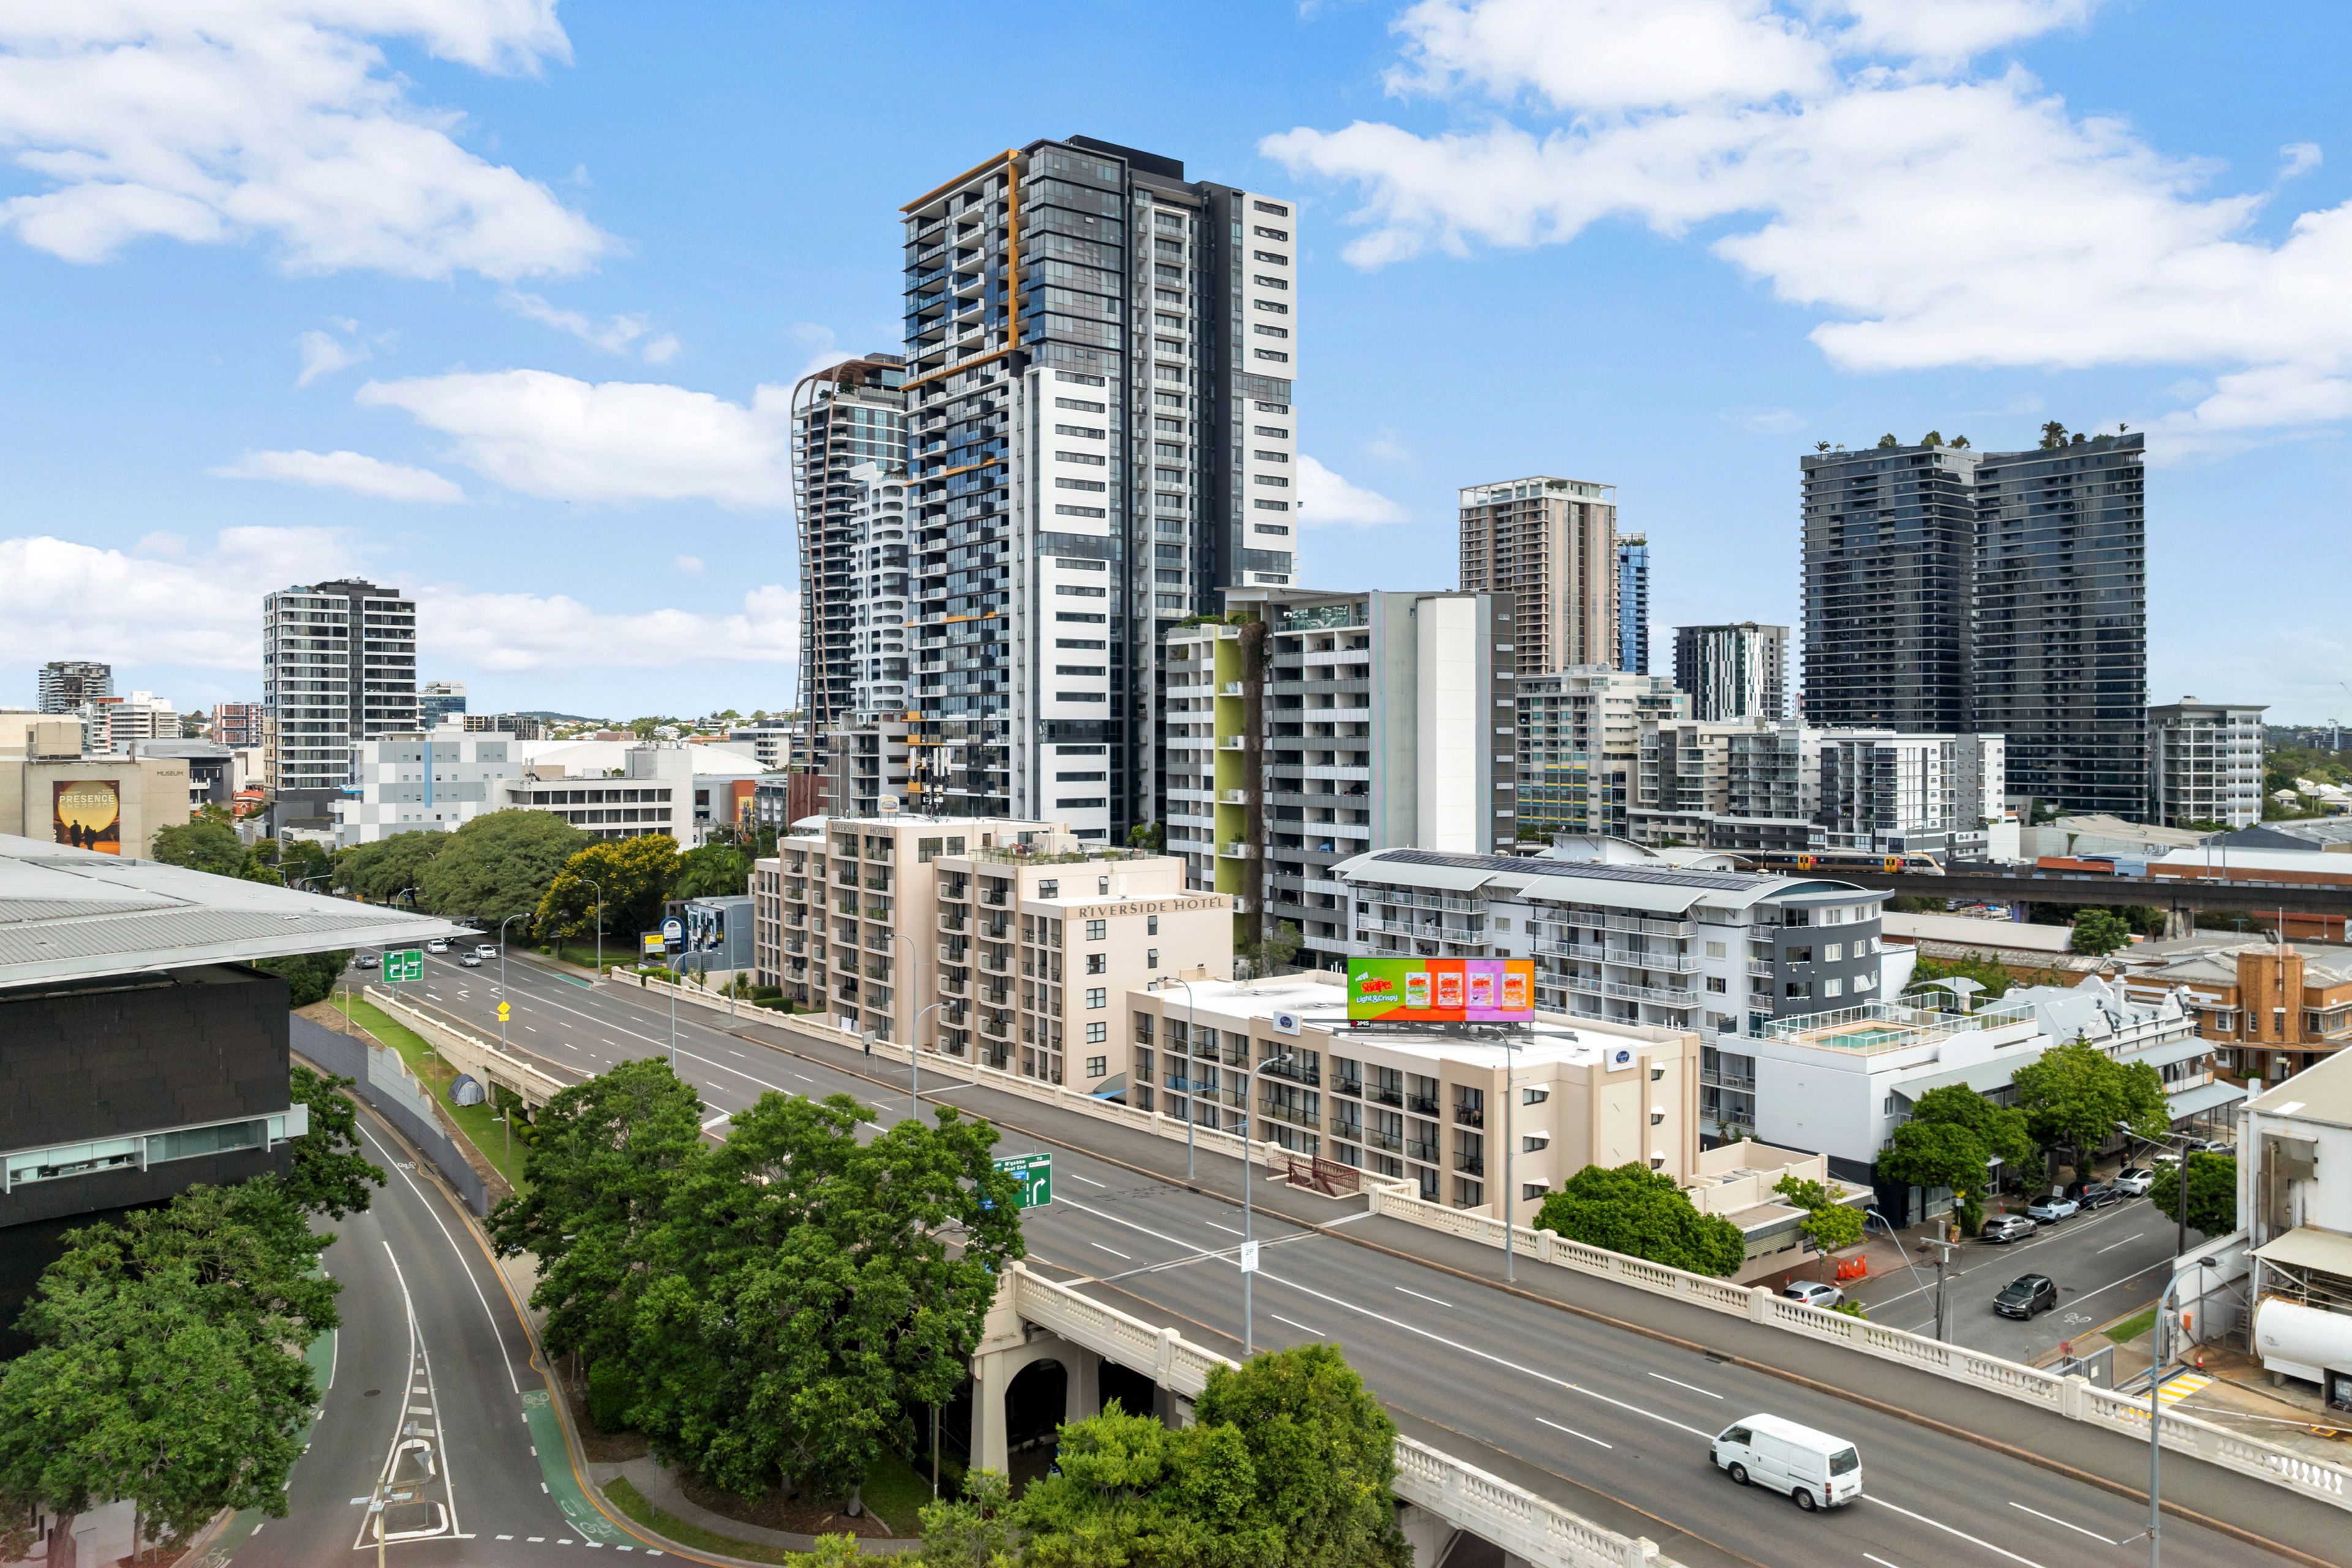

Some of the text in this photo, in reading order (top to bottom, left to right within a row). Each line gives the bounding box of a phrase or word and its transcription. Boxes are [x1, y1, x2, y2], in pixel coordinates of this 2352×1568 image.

[831, 823, 889, 837] RIVERSIDE HOTEL
[1079, 897, 1224, 918] RIVERSIDE HOTEL
